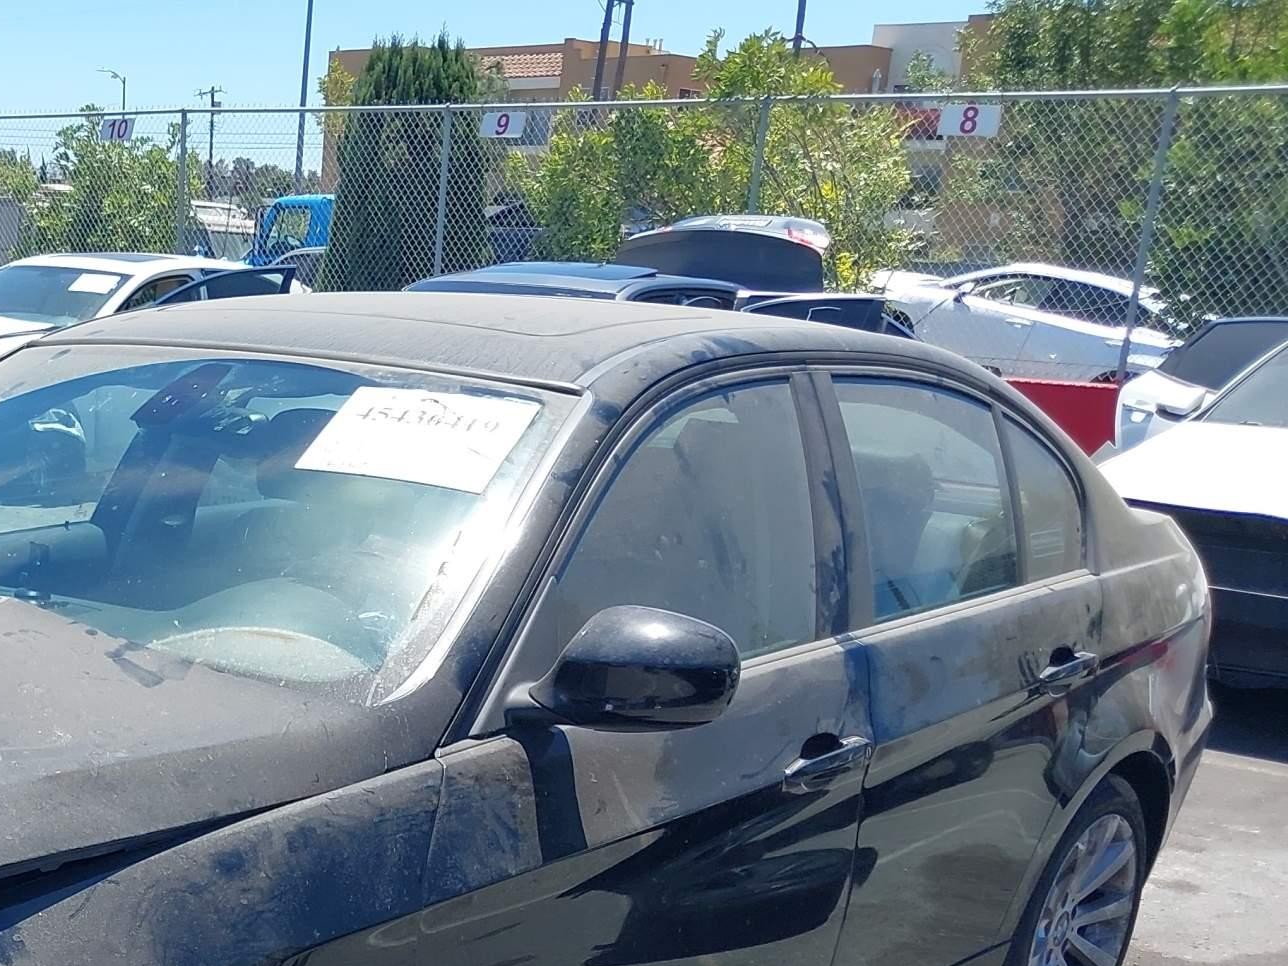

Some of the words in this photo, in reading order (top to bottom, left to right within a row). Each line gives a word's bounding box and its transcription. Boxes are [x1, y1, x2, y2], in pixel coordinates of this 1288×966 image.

[108, 119, 128, 139] 10
[495, 113, 510, 136] 9
[959, 105, 979, 134] 8
